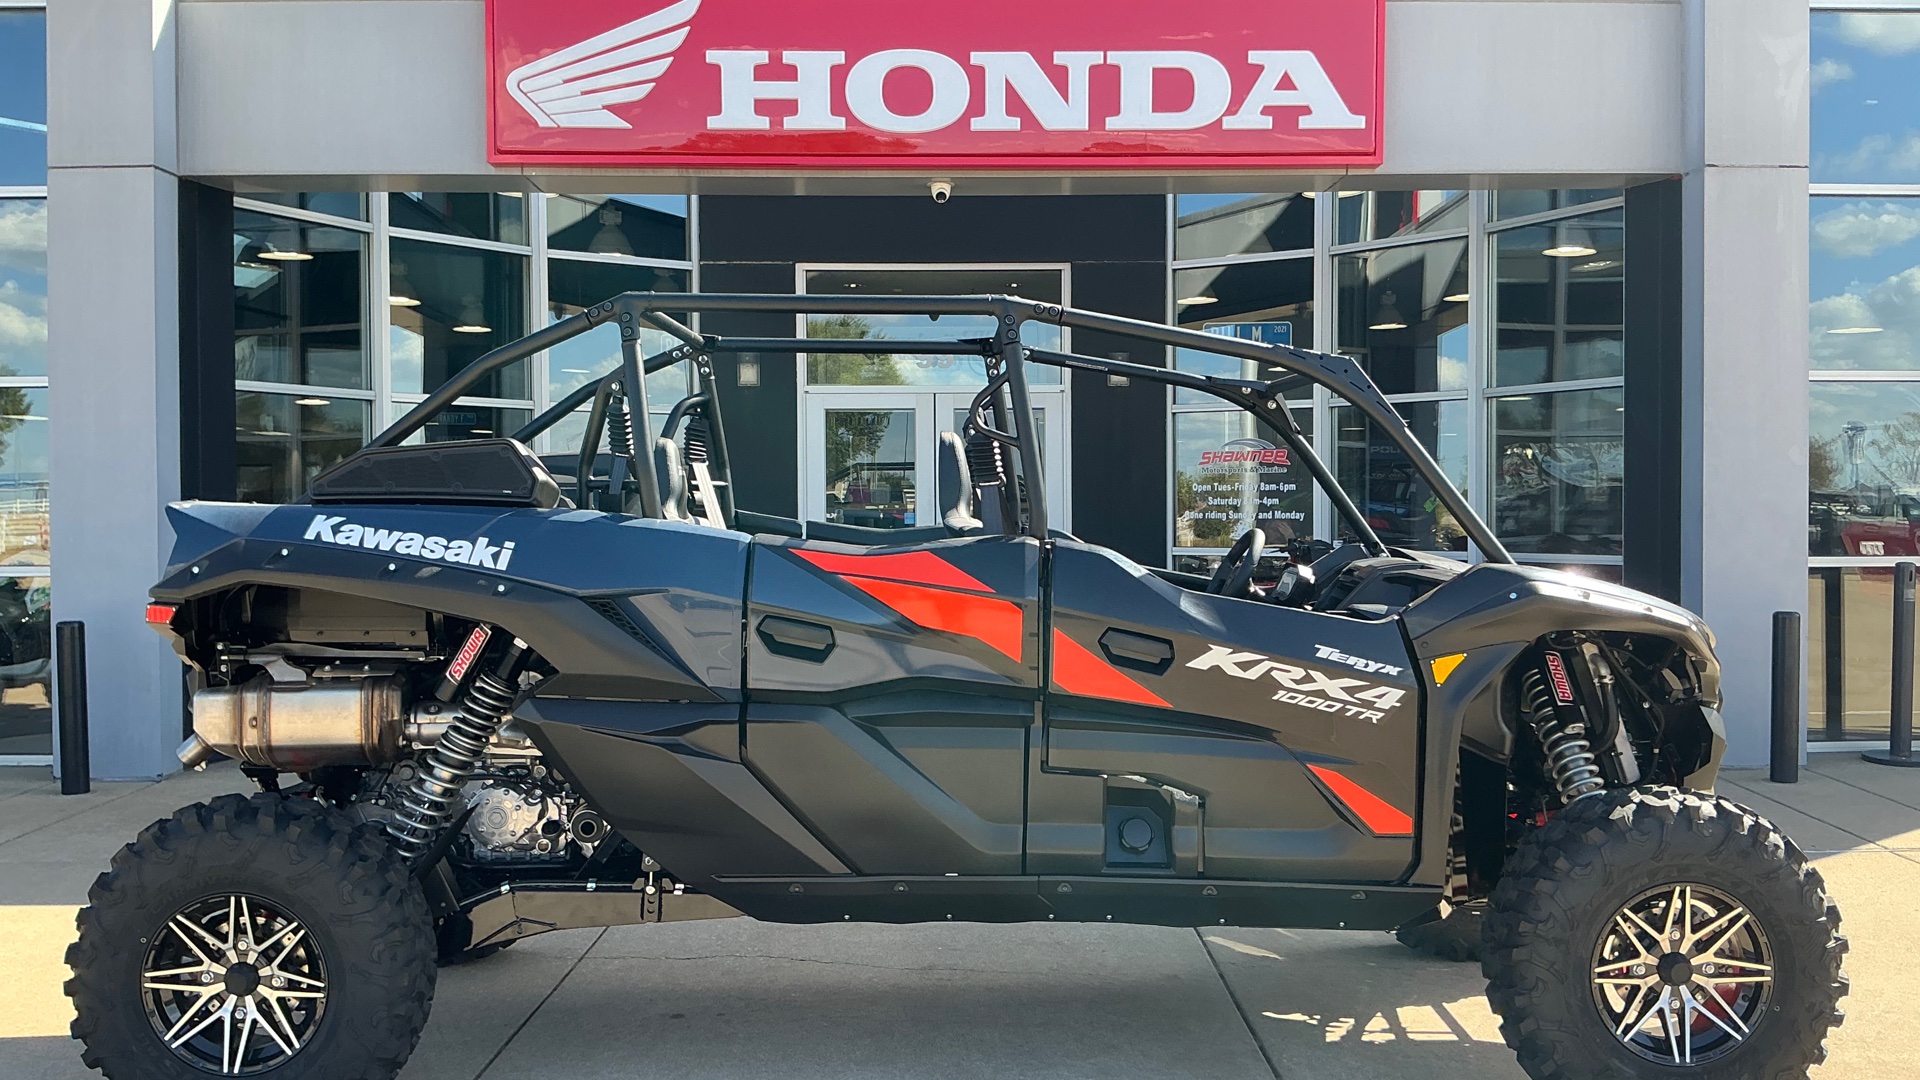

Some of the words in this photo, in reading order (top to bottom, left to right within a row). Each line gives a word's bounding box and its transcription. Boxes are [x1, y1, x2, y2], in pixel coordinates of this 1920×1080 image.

[704, 49, 1367, 132] HONDA
[1273, 325, 1287, 333] 2021
[1201, 466, 1248, 475] Motorsports
[1258, 465, 1288, 474] Marine
[1192, 483, 1212, 493] Open
[1214, 482, 1258, 493] Tues-Friday
[1260, 482, 1297, 493] 8am-6pm
[1207, 496, 1242, 507] Saturday
[1205, 510, 1227, 521] riding
[1257, 510, 1273, 520] and
[1274, 510, 1305, 521] Monday
[303, 514, 515, 571] Kawasaki
[451, 627, 486, 681] SHOWA
[1184, 643, 1407, 710] KRX4
[1545, 655, 1574, 701] SHOWA
